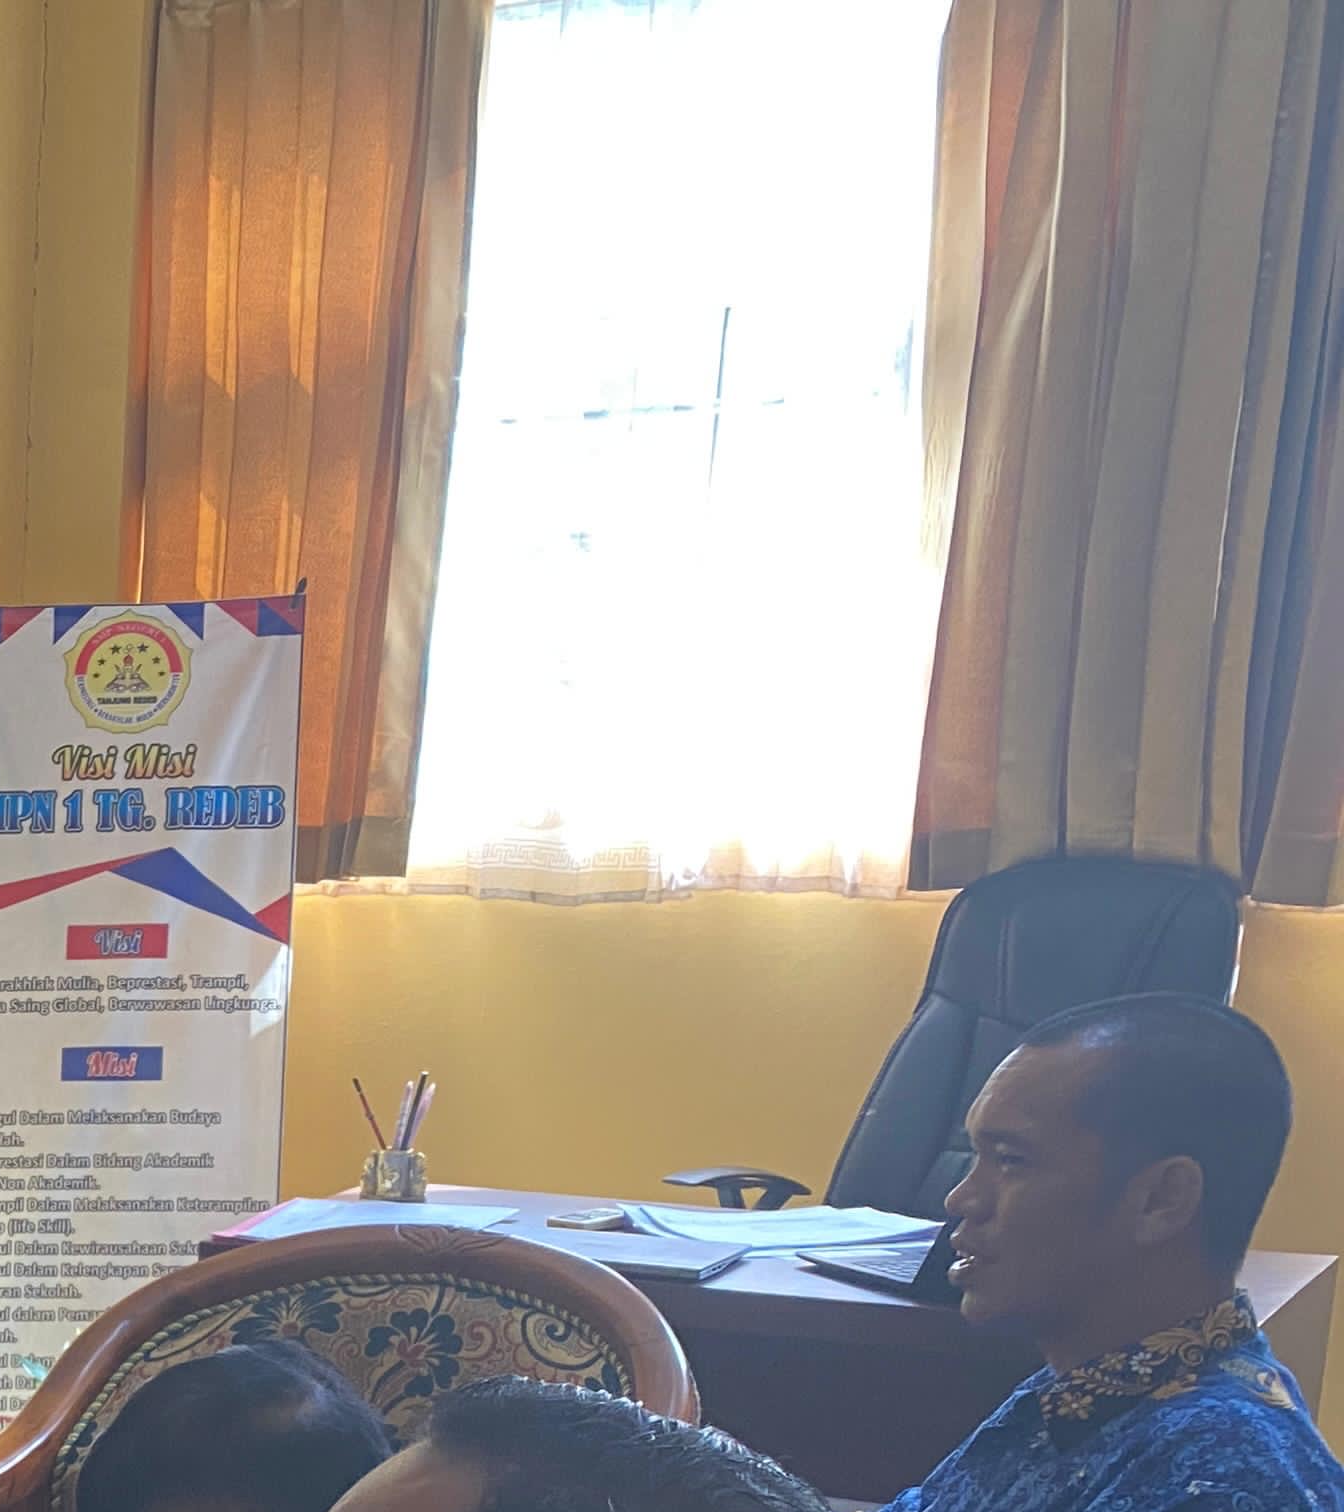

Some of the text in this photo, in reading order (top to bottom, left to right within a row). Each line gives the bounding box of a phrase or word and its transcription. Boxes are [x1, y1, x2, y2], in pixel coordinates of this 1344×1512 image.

[52, 743, 198, 781] Visi Misi
[63, 789, 84, 834] 1
[94, 788, 156, 833] TG.
[164, 785, 286, 830] REDEB
[95, 928, 143, 955] Visi
[57, 976, 105, 993] Mulia,
[107, 975, 188, 994] Beprestasi,
[190, 974, 250, 993] Trampil,
[9, 998, 51, 1017] Saing
[53, 997, 105, 1015] Global,
[107, 996, 201, 1011] Berwawasan
[204, 995, 281, 1014] Lingkunga.
[86, 1051, 139, 1078] Misi
[19, 1111, 65, 1125] Dalam
[67, 1110, 168, 1126] Melaksanakan
[169, 1110, 222, 1129] Budaya
[46, 1154, 91, 1170] Dalam
[93, 1153, 142, 1172] Bidang
[143, 1153, 215, 1170] Akademik
[27, 1175, 101, 1191] Akademik.
[27, 1197, 70, 1213] Dalam
[73, 1197, 175, 1213] Melaksanakan
[177, 1198, 270, 1216] Keterampilan
[7, 1218, 36, 1236] (life
[14, 1240, 59, 1256] Dalam
[61, 1240, 167, 1257] Kewirausahaan
[12, 1262, 56, 1278] Dalam
[60, 1262, 149, 1281] Kelengkapan
[23, 1284, 82, 1299] Sekolah.
[12, 1308, 56, 1322] dalam
